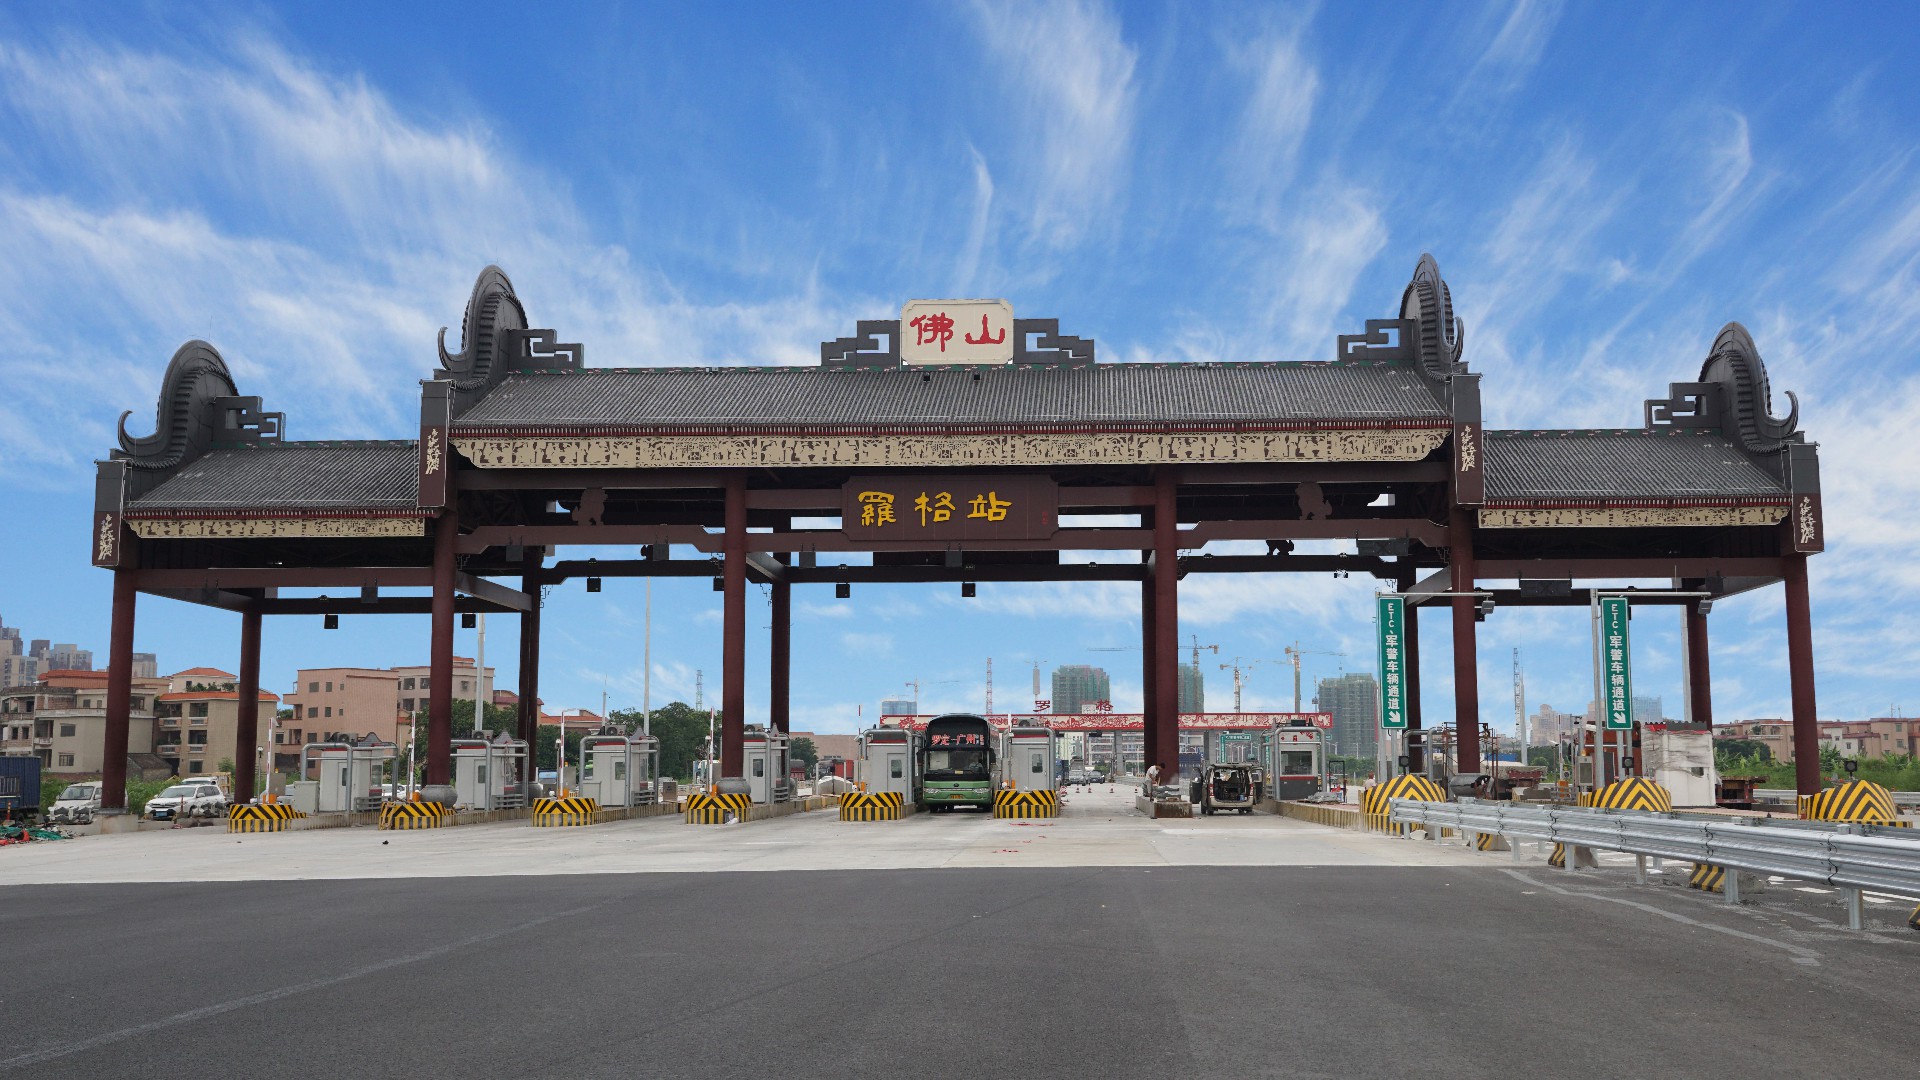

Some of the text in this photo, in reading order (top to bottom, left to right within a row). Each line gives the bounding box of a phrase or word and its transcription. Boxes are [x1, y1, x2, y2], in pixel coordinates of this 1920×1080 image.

[910, 312, 1006, 352] 佛山
[858, 491, 1013, 527] 羅格站
[1385, 602, 1400, 710] ETC、军警车辆通道
[1609, 603, 1626, 711] ETC、军警车辆通道
